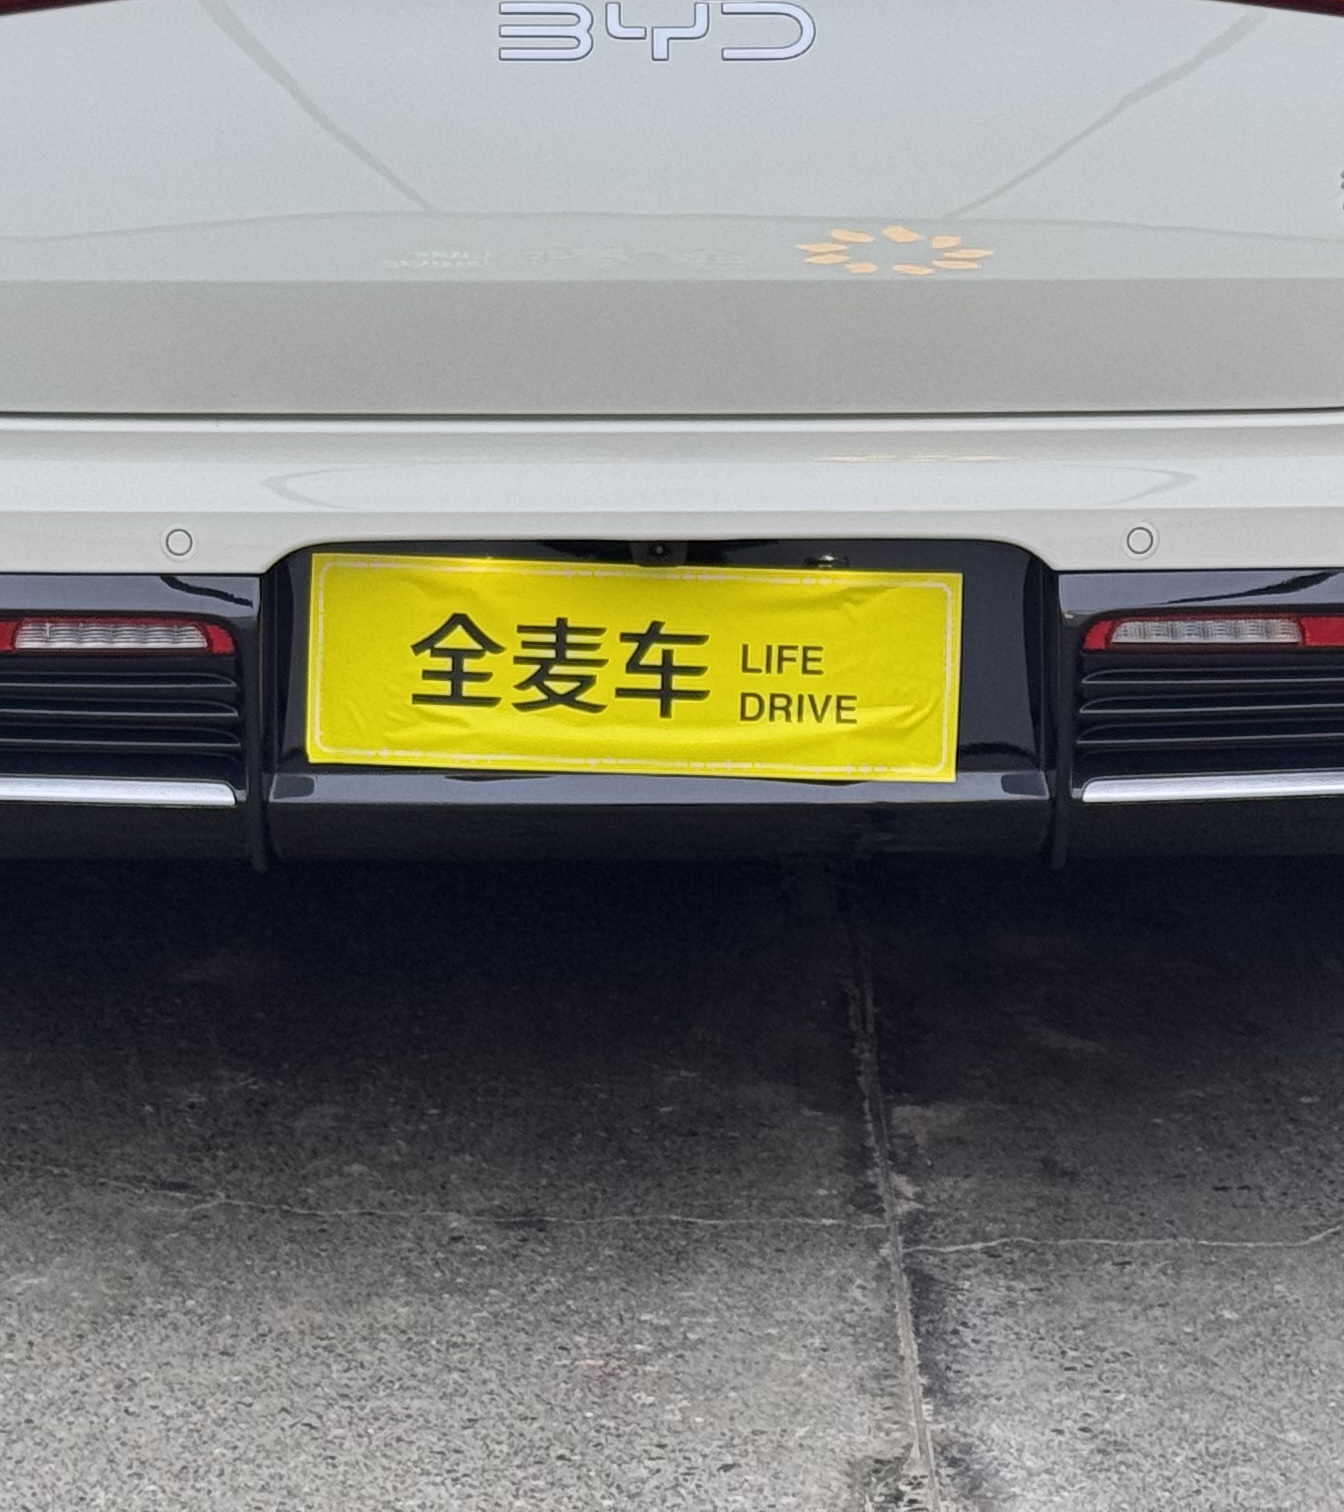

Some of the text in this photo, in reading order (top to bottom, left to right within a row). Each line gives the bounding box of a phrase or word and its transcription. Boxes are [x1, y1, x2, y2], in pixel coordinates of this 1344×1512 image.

[499, 1, 816, 61] BYD
[410, 611, 711, 719] 全麦车
[741, 642, 825, 676] LIFE
[739, 691, 859, 725] DRIVE
